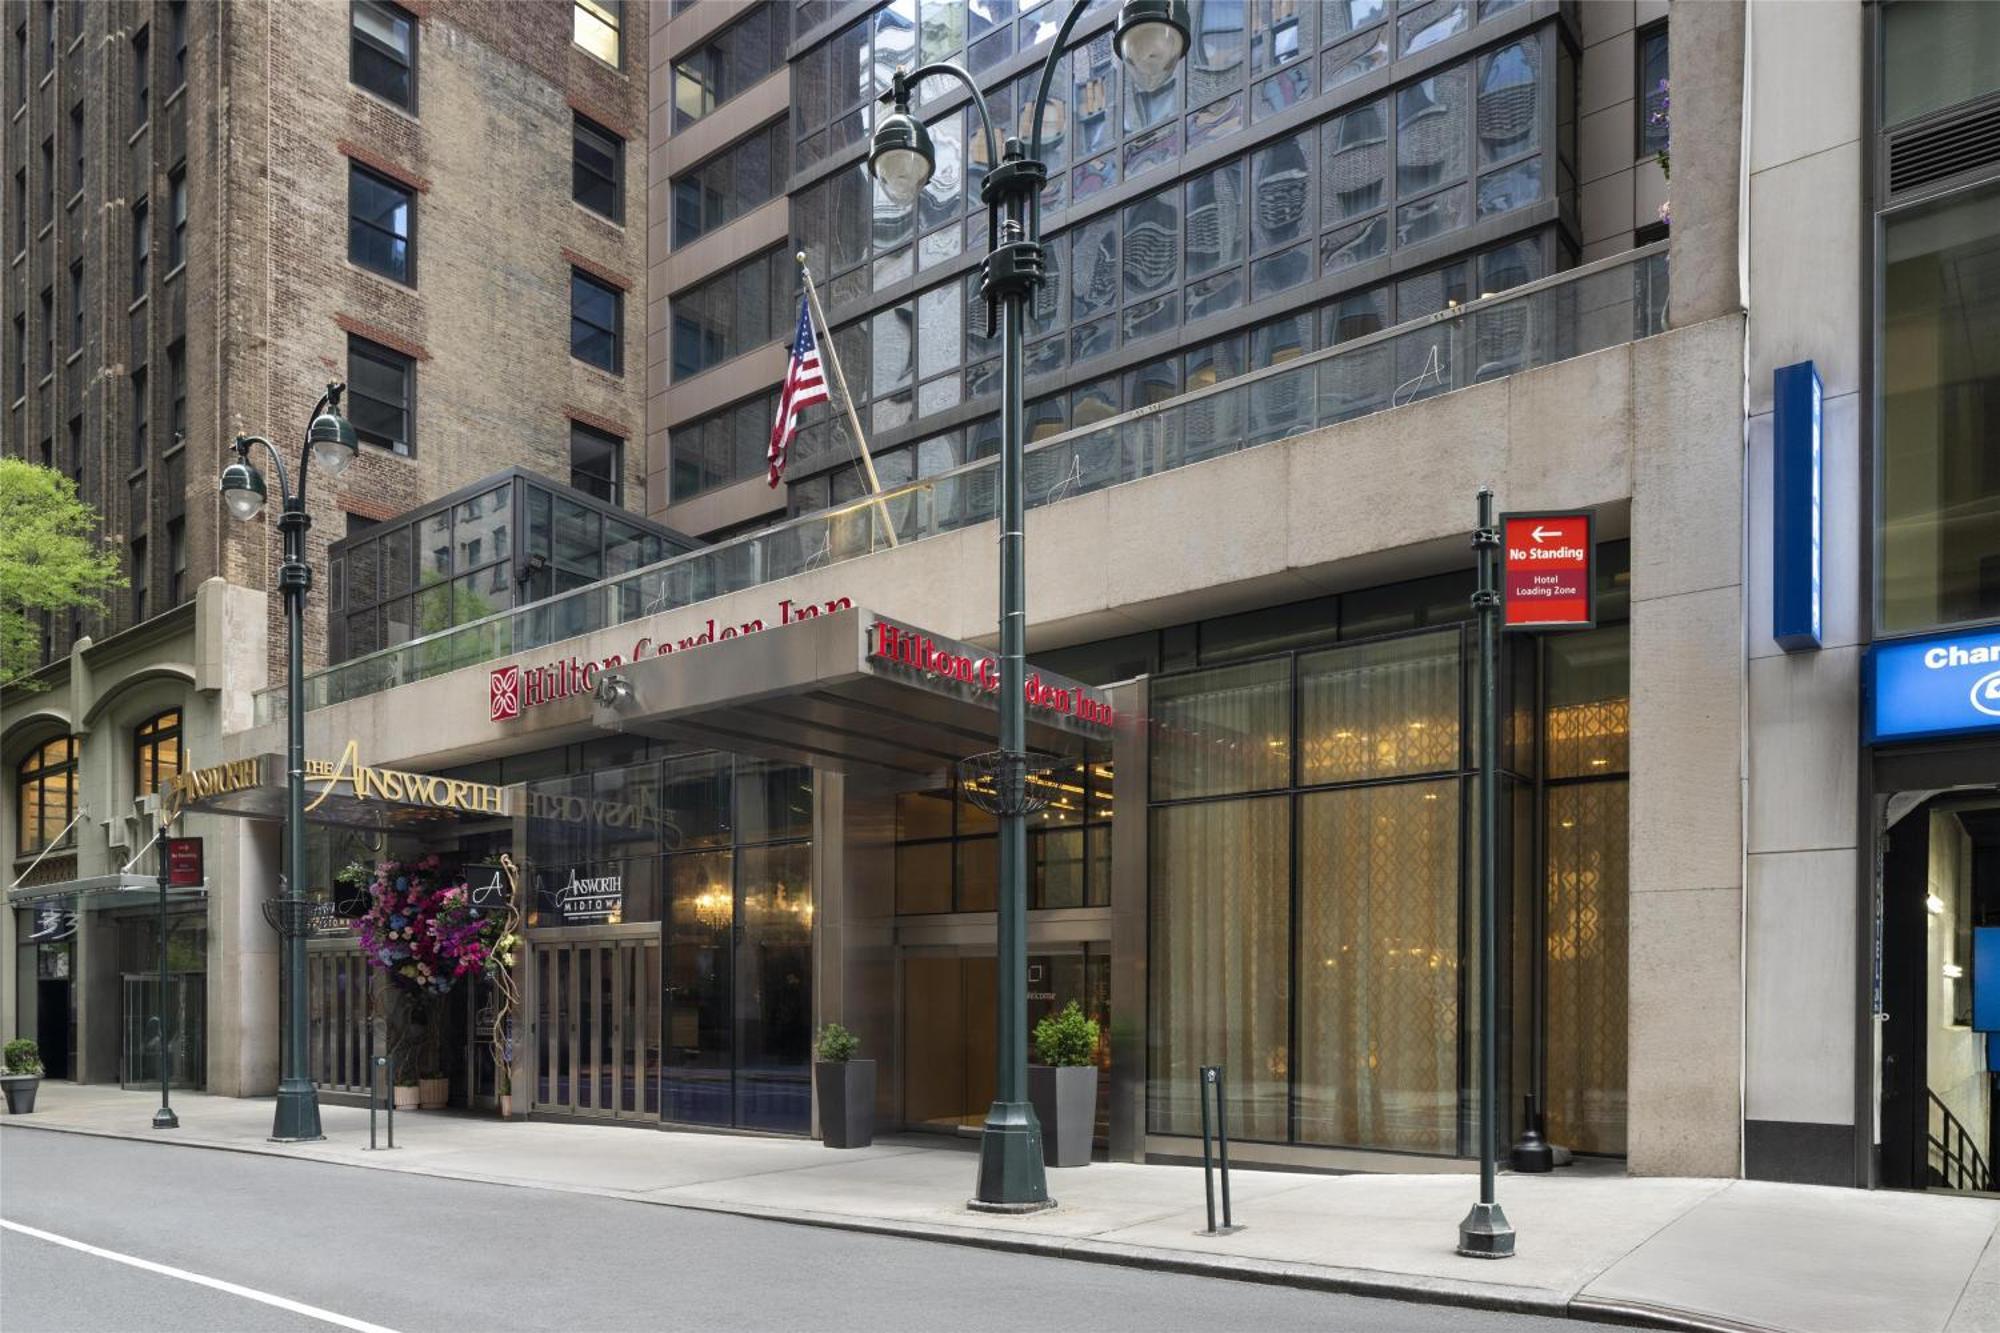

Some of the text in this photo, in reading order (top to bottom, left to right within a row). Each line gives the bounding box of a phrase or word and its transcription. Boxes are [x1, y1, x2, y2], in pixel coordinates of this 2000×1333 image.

[1509, 546, 1584, 561] No Standing
[1516, 586, 1577, 597] Loading Zone
[1534, 575, 1559, 585] Hotel
[874, 620, 1113, 728] Hilton Gden Inn
[304, 740, 504, 813] THE AINSWORTH
[556, 868, 622, 908] AINSWORTH
